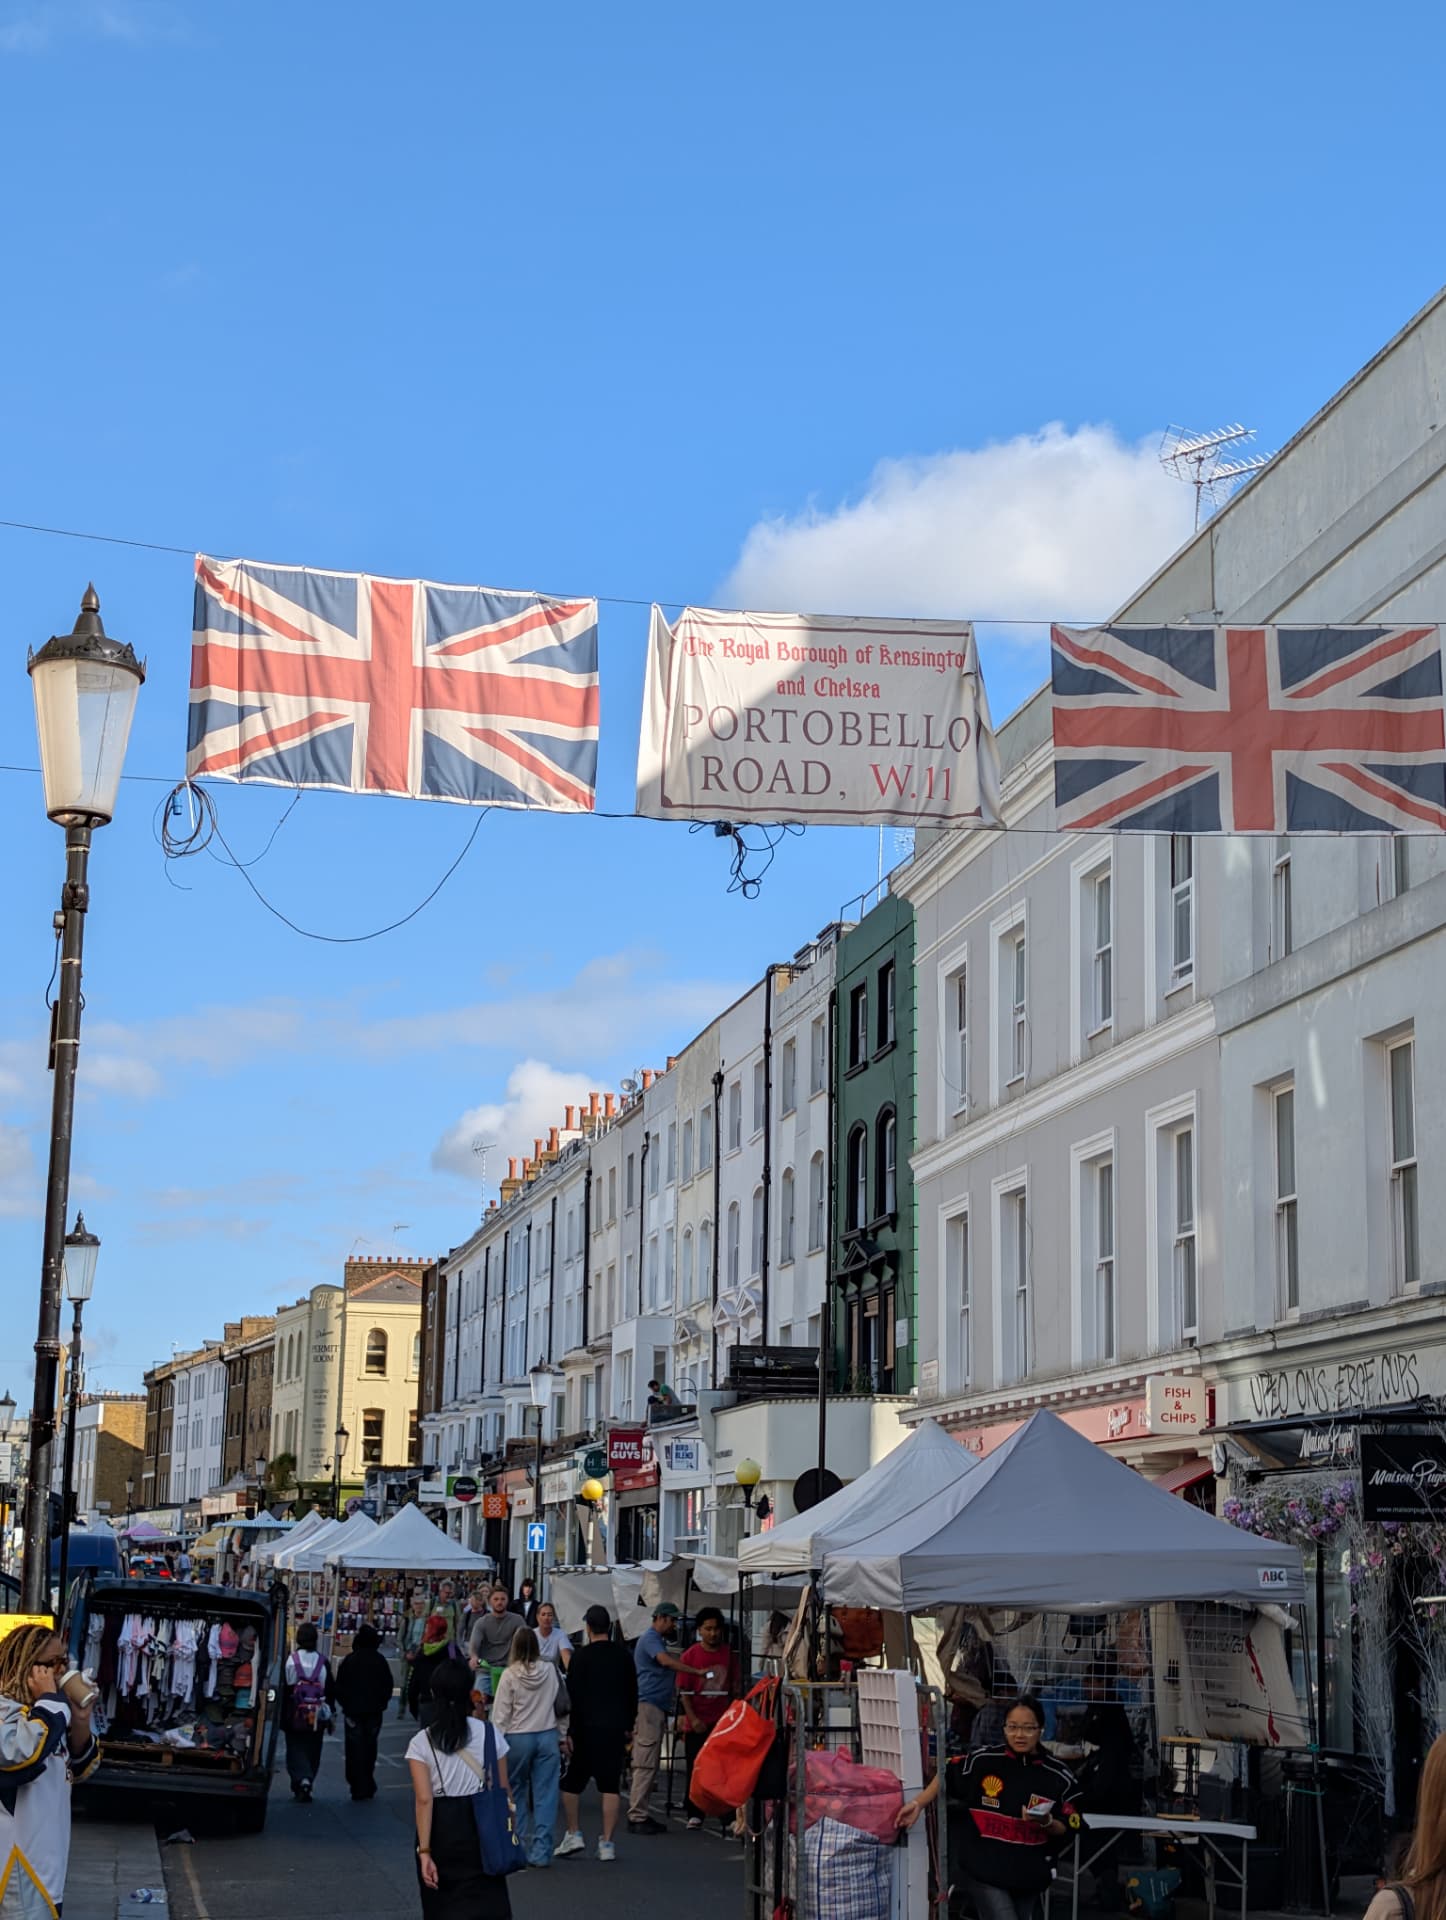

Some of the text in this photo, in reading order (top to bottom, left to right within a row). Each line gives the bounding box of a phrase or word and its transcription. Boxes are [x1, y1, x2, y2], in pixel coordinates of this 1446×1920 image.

[683, 636, 966, 673] The Royal Borough of Kensingto
[776, 677, 881, 699] and Chelsea
[682, 703, 971, 753] PORTOBELLO
[869, 763, 951, 801] W.11
[1165, 1387, 1191, 1399] FISH
[1173, 1401, 1183, 1410] &
[1160, 1413, 1197, 1424] CHIPS
[613, 1441, 638, 1450] FIVE
[610, 1450, 641, 1460] GUYS
[1368, 1468, 1414, 1486] Maison
[1262, 1570, 1284, 1582] ABC
